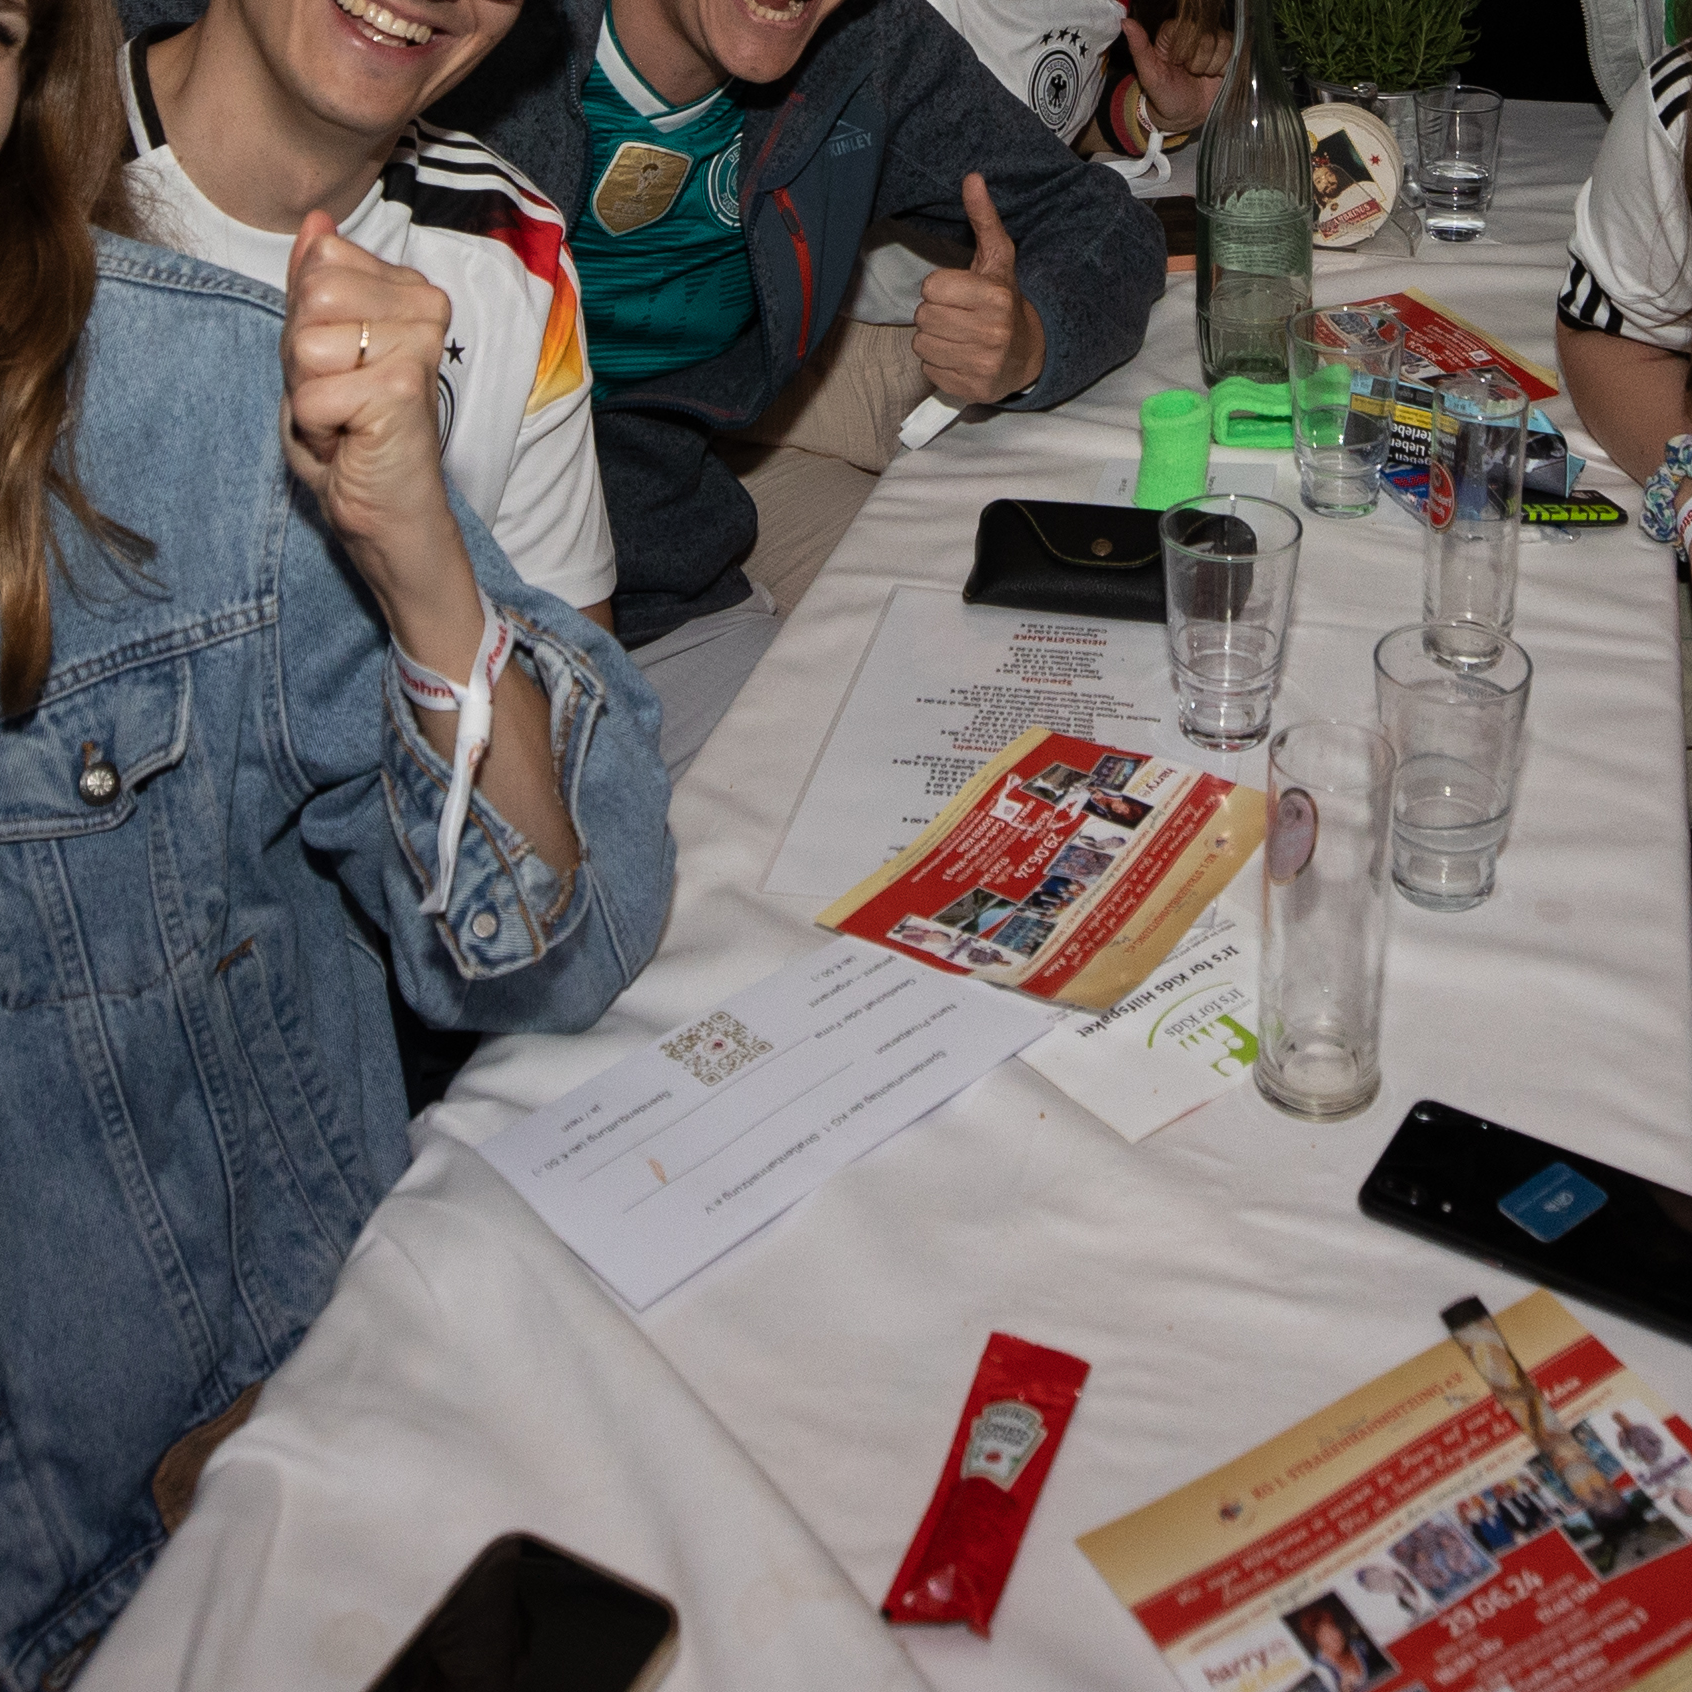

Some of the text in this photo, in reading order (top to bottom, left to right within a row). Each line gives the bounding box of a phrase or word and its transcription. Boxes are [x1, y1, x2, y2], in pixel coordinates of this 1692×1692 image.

[1521, 503, 1618, 521] GIZEH
[1021, 676, 1071, 685] Specials
[1010, 831, 1066, 881] 29.06.24
[1187, 960, 1213, 977] for
[1154, 972, 1189, 994] Kids
[1075, 991, 1156, 1038] Hilfspaket
[1197, 999, 1223, 1019] for
[1163, 1013, 1200, 1039] Kids
